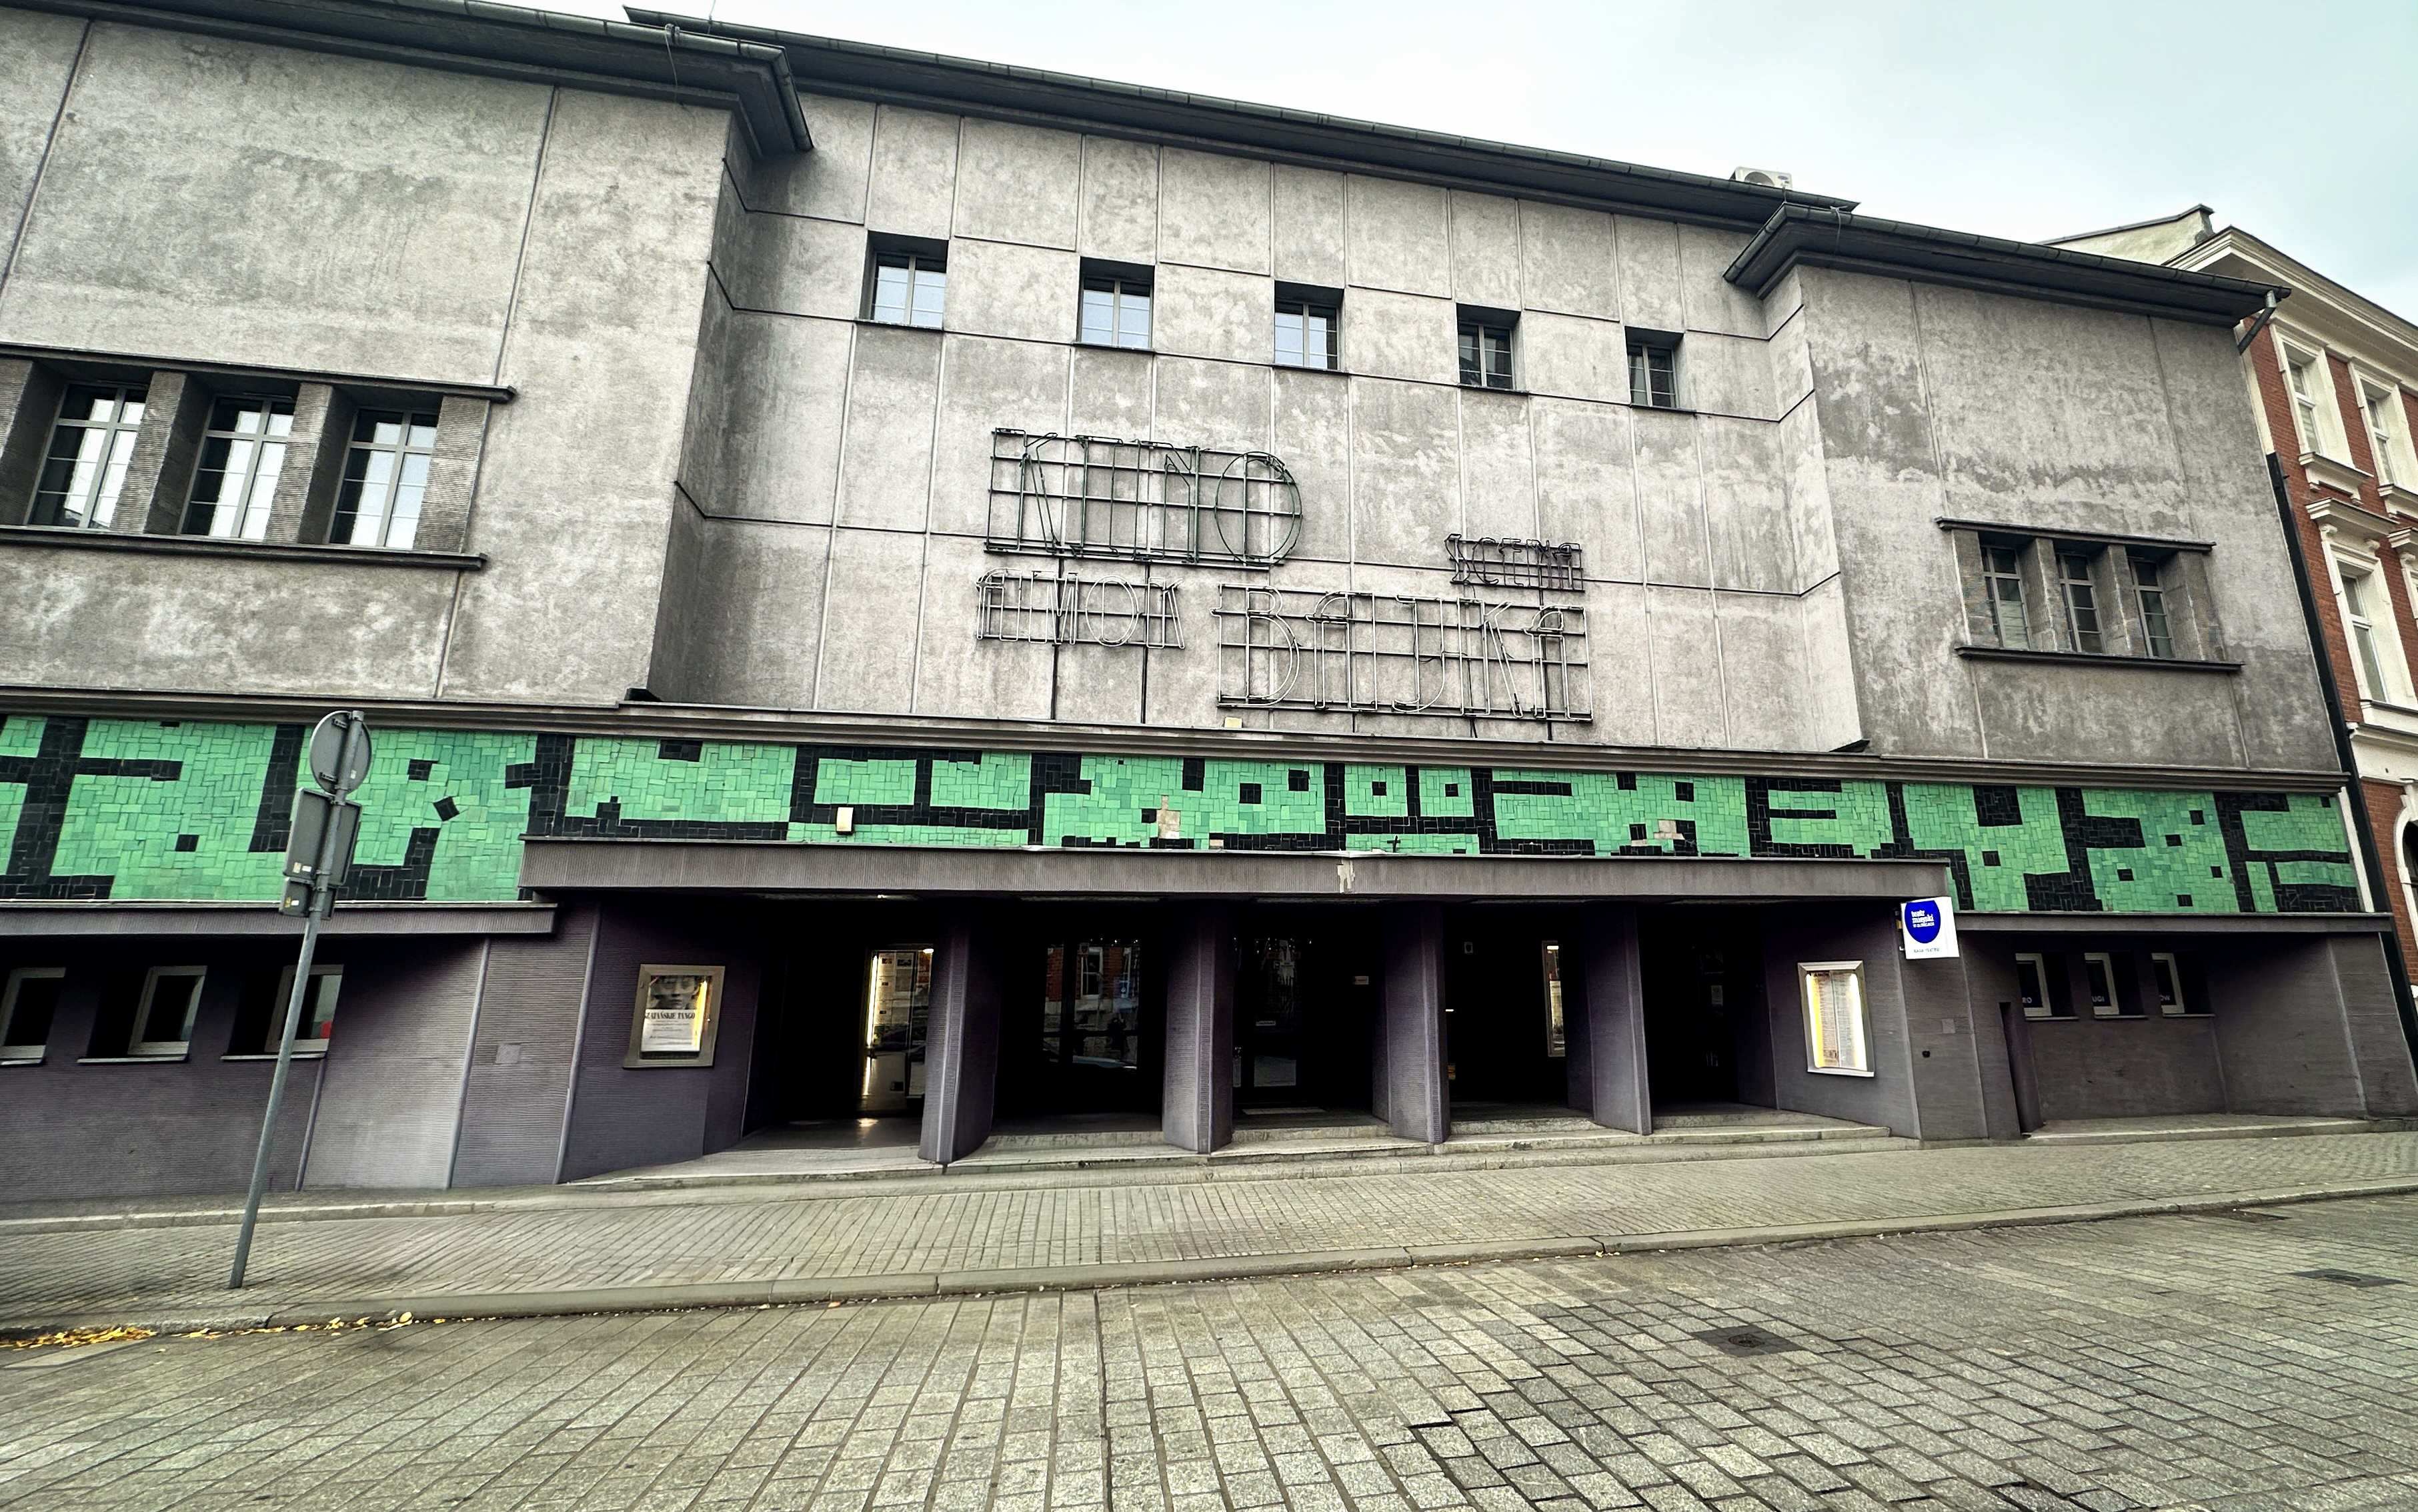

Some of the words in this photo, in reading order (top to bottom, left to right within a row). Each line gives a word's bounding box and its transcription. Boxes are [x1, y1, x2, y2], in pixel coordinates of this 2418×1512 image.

[986, 427, 1302, 566] KINO
[976, 567, 1186, 649] AMOK
[1210, 583, 1594, 721] BAJKA
